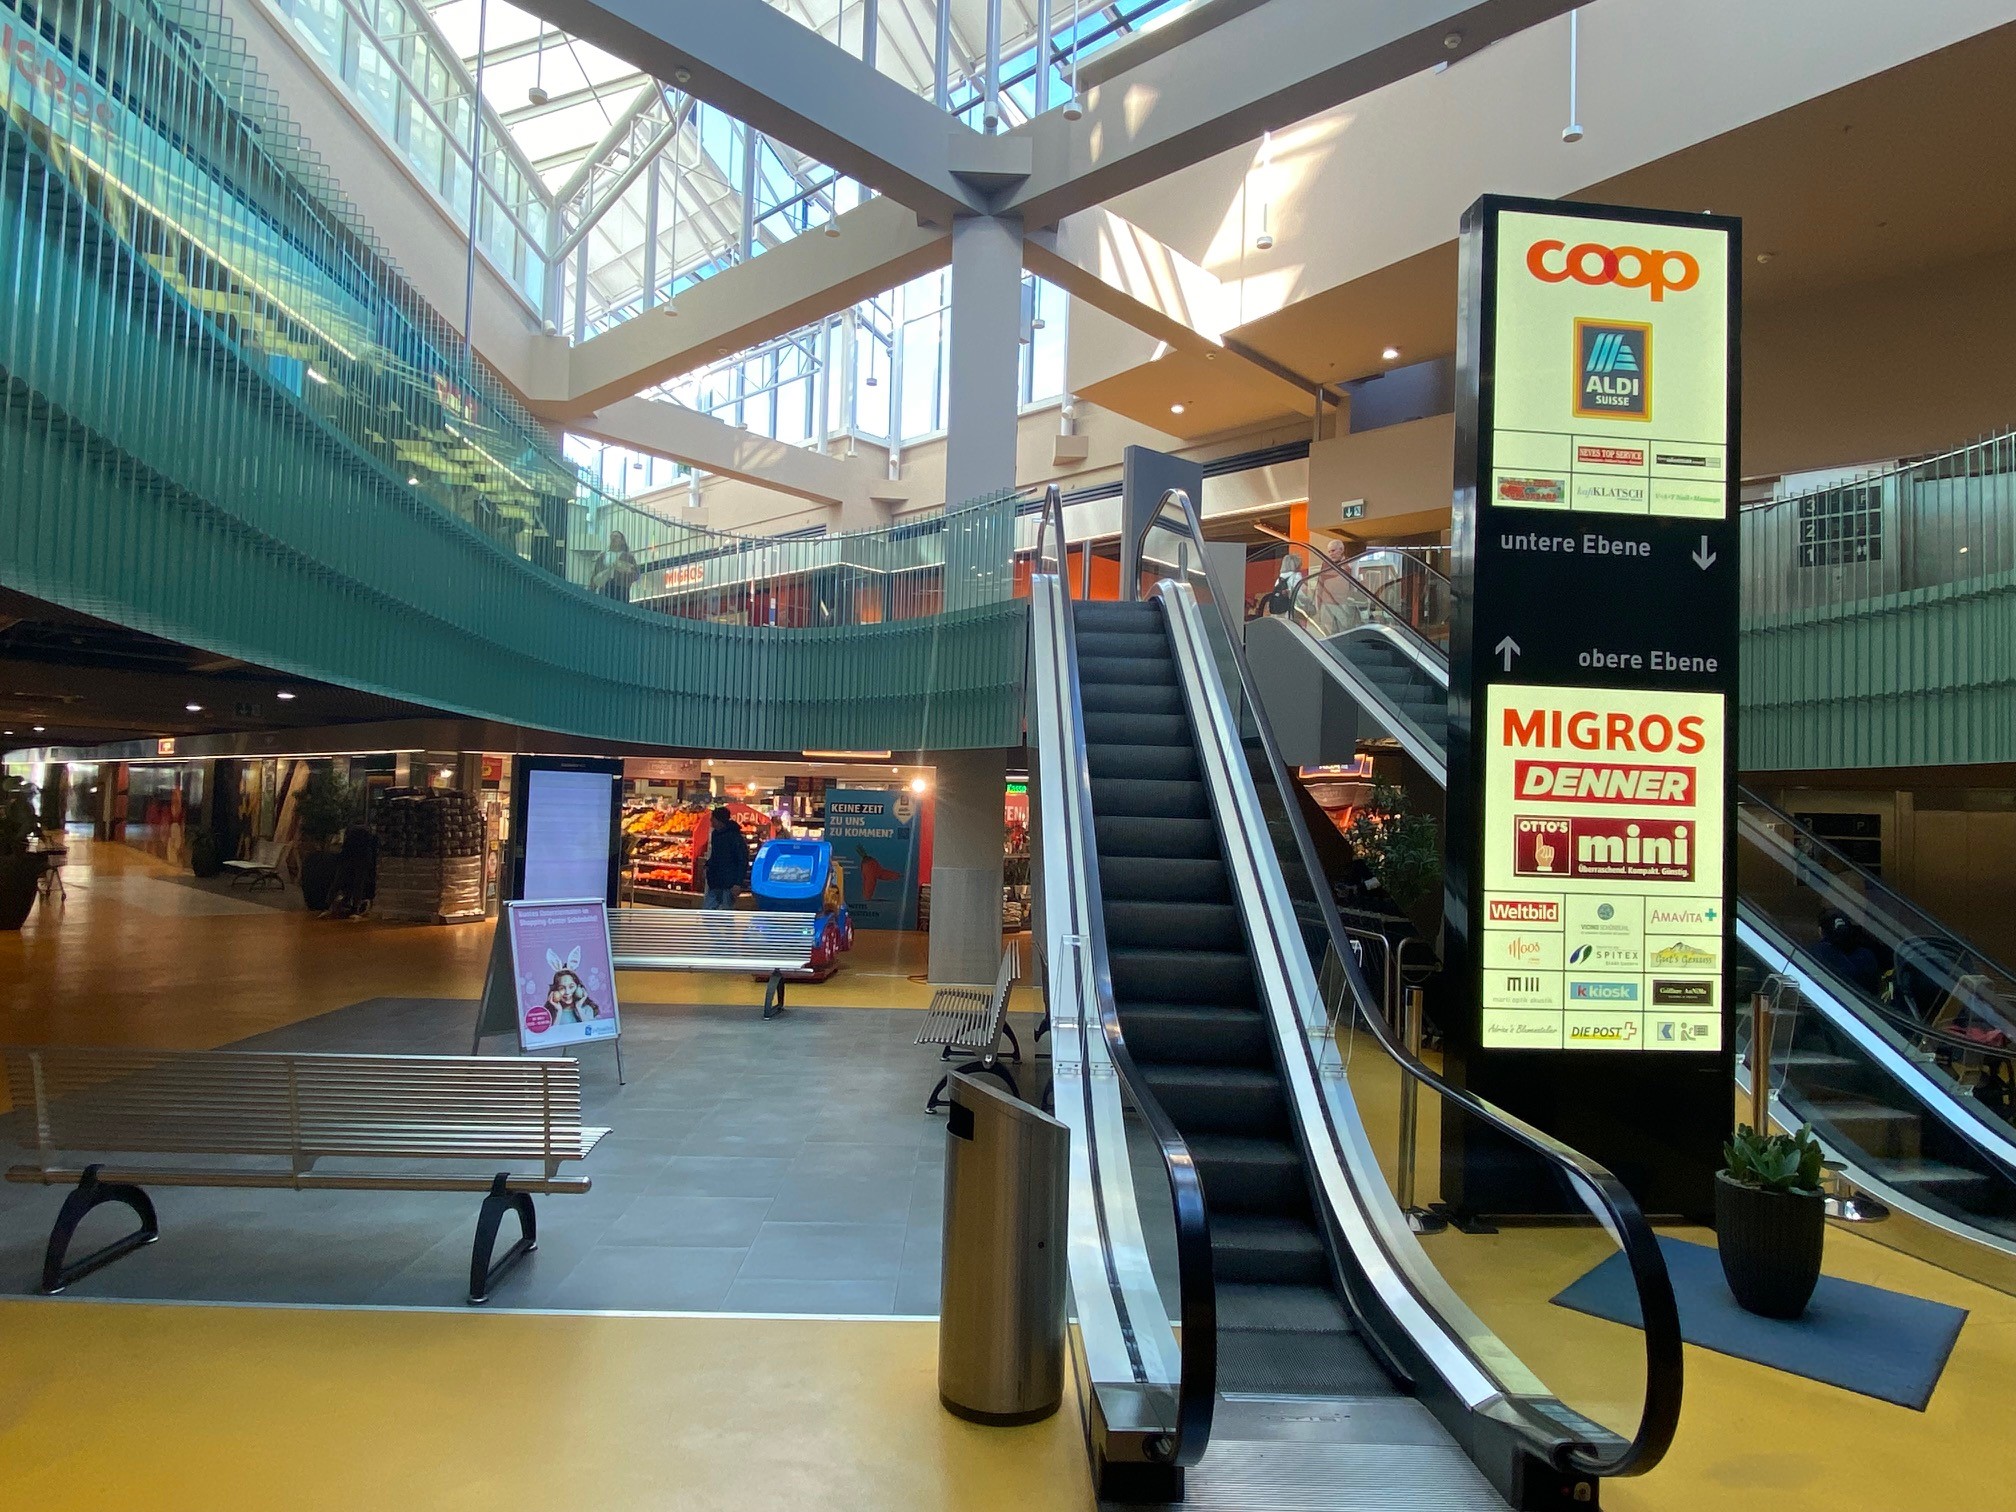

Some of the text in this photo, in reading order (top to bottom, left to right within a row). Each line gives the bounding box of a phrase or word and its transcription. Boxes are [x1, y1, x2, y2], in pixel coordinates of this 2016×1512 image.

[1526, 239, 1700, 302] coop
[1586, 375, 1639, 396] ALDI
[1596, 395, 1630, 406] SUISSE
[1602, 449, 1616, 458] TOP
[1806, 500, 1815, 512] 3
[1806, 524, 1815, 538] 2
[1500, 532, 1650, 556] untere Ebene
[1807, 549, 1814, 562] 1
[664, 566, 703, 585] MIGROS
[1578, 648, 1718, 672] obere Ebene
[1503, 708, 1706, 754] MIGROS
[1522, 766, 1690, 801] DENNER
[831, 803, 884, 814] KEINE ZEIT
[830, 816, 865, 826] ZU UNS
[1520, 820, 1568, 834] OTTO'S
[830, 828, 894, 838] ZU KOMMEN?
[1578, 824, 1688, 866] mini
[1578, 864, 1689, 878] Überraschend. Kompakt. Günstig.
[1491, 903, 1557, 920] Weltbild
[1596, 951, 1638, 959] SPITEX
[1589, 985, 1630, 998] kiosk
[1571, 1026, 1622, 1038] DIE POST
